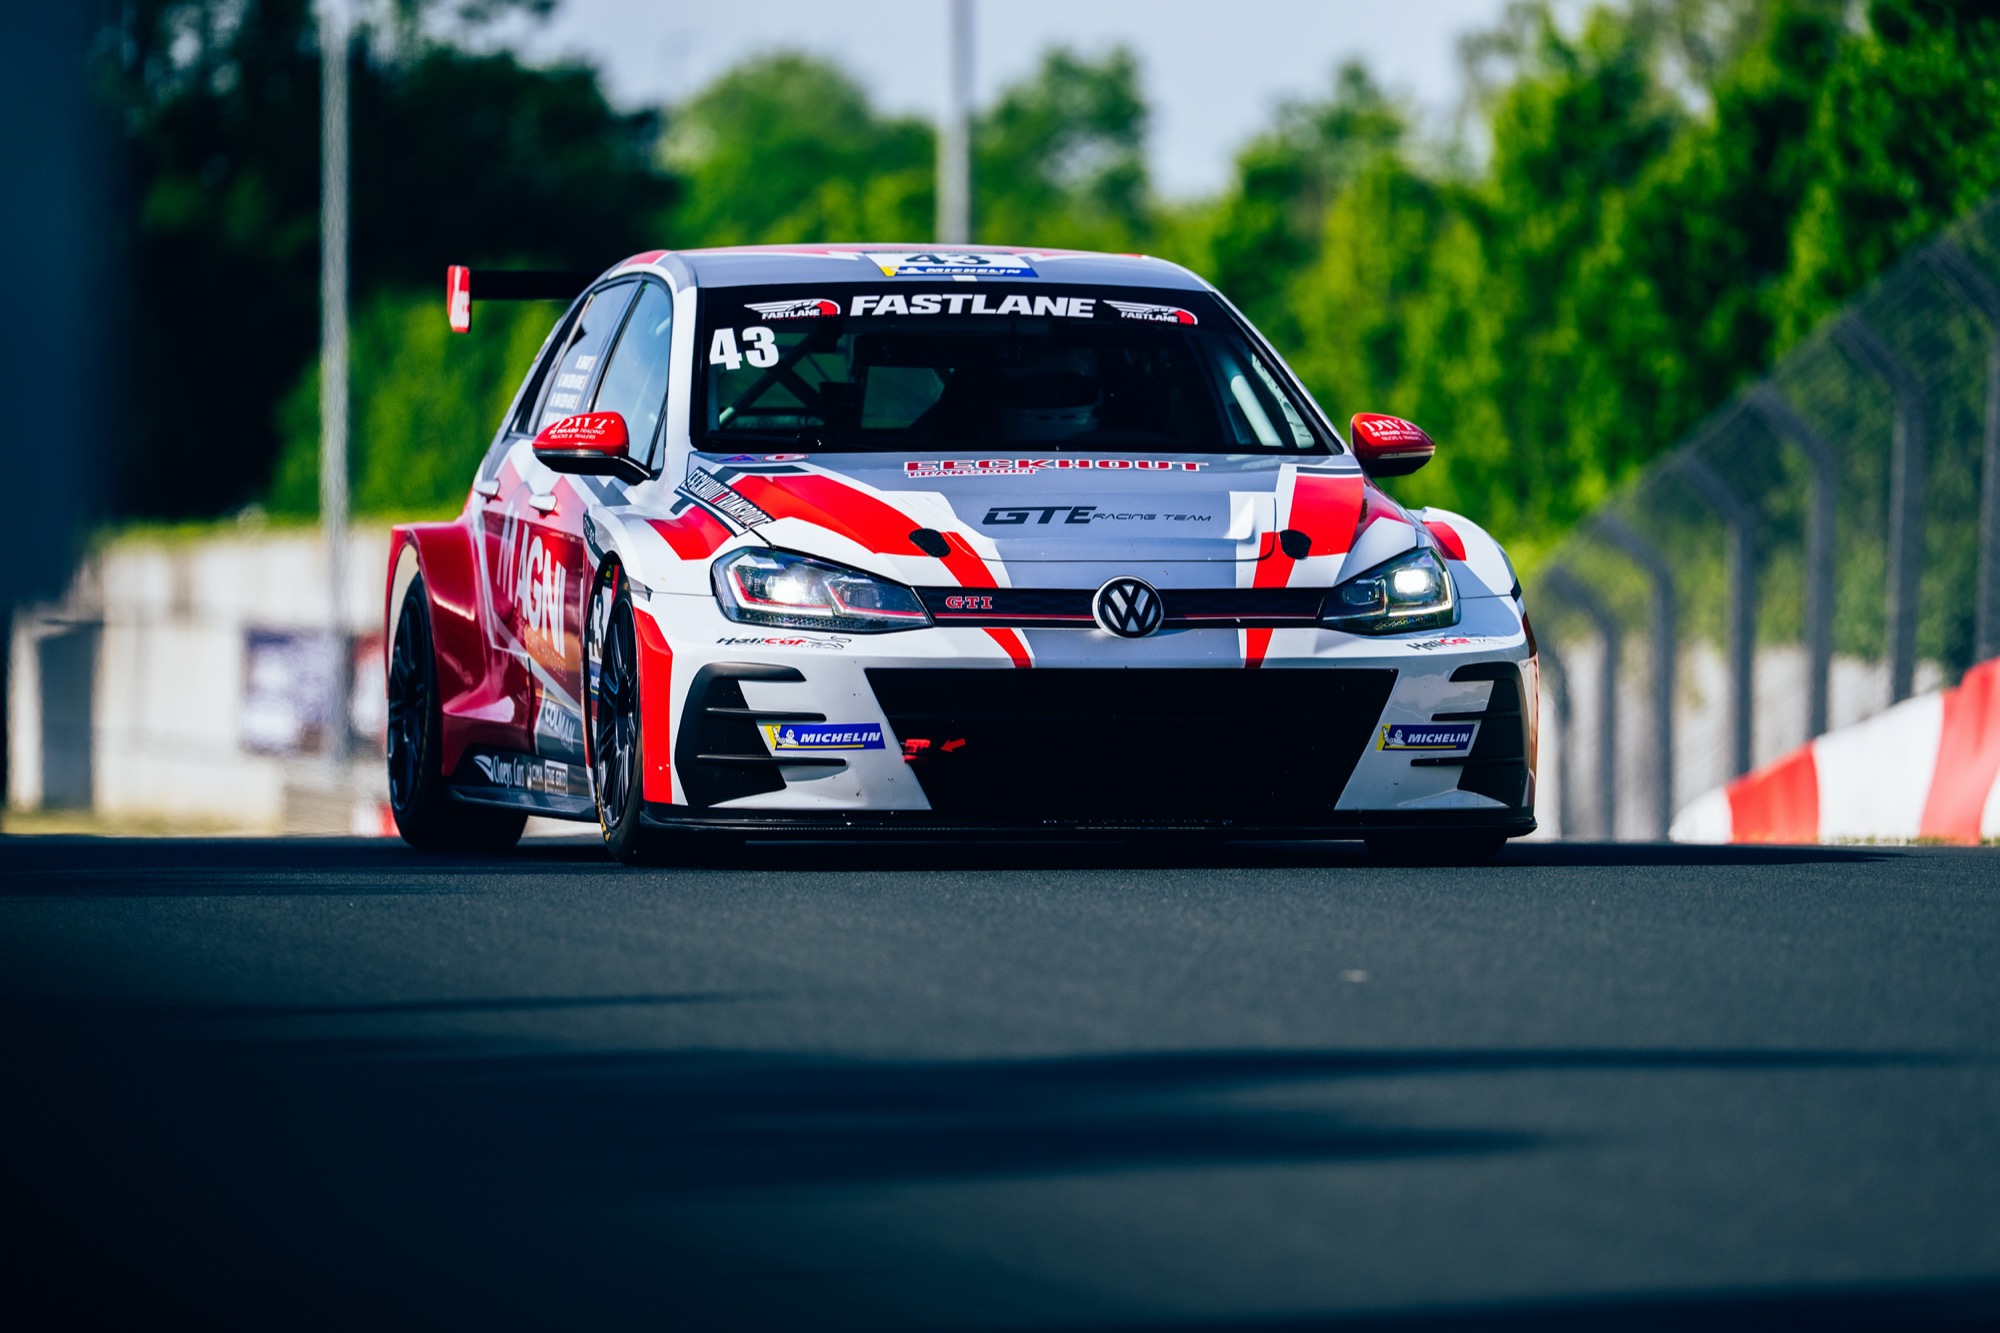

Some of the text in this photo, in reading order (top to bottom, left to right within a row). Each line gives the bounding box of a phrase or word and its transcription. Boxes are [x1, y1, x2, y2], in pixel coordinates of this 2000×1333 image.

[905, 254, 990, 265] 43
[925, 267, 1021, 275] MICHELIN
[850, 294, 1096, 318] FASTLANE
[761, 309, 820, 320] FASTLANE
[1121, 312, 1178, 323] FASTLANE
[709, 326, 779, 371] 43
[904, 459, 1209, 472] EECKHOUT
[904, 469, 1039, 479] TRANSPORT
[682, 469, 773, 528] EECKHOUT TRANSPORT
[982, 506, 1097, 525] GTE
[496, 500, 567, 659] MAGNI
[945, 596, 993, 609] GTI
[544, 699, 576, 744] COLMAN
[800, 731, 881, 743] MICHELIN
[1407, 732, 1470, 743] MICHELIN
